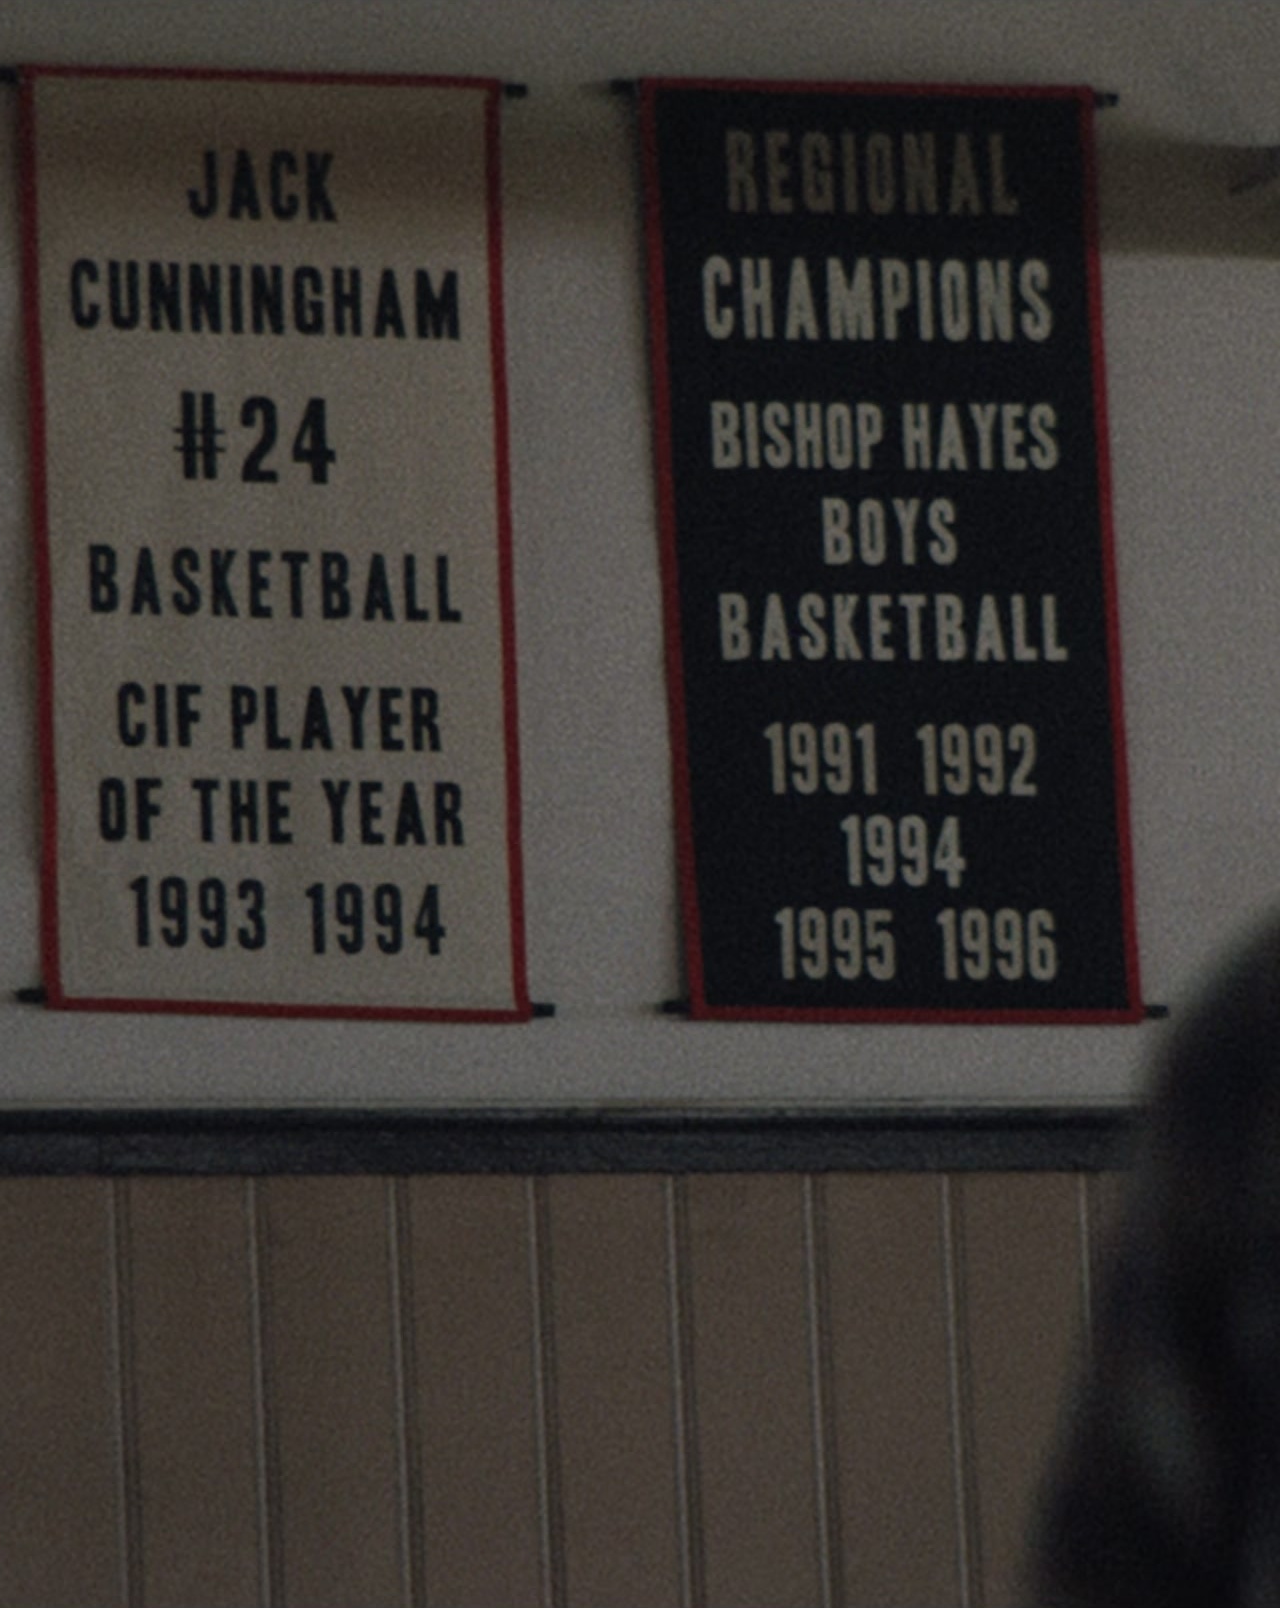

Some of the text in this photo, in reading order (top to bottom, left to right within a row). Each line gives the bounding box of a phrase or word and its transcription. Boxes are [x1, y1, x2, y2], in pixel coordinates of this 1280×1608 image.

[188, 149, 337, 222] JACK
[725, 127, 1019, 217] REGIONAL
[71, 259, 461, 340] CUNNINGHAM
[701, 254, 1054, 343] CHAMPIONS
[174, 390, 336, 485] #24
[710, 400, 1060, 472] BISHOP HAYES
[822, 497, 959, 567] BOYS
[89, 544, 463, 622] BASKETBALL
[717, 591, 1069, 662] BASKETBALL
[118, 682, 441, 752] CIF PLAYER
[763, 721, 1038, 797] 1991 1992
[99, 777, 464, 846] OF THE YEAR
[839, 813, 967, 889] 1994
[129, 876, 446, 955] 1993 1994
[774, 906, 1057, 982] 1995 1996
